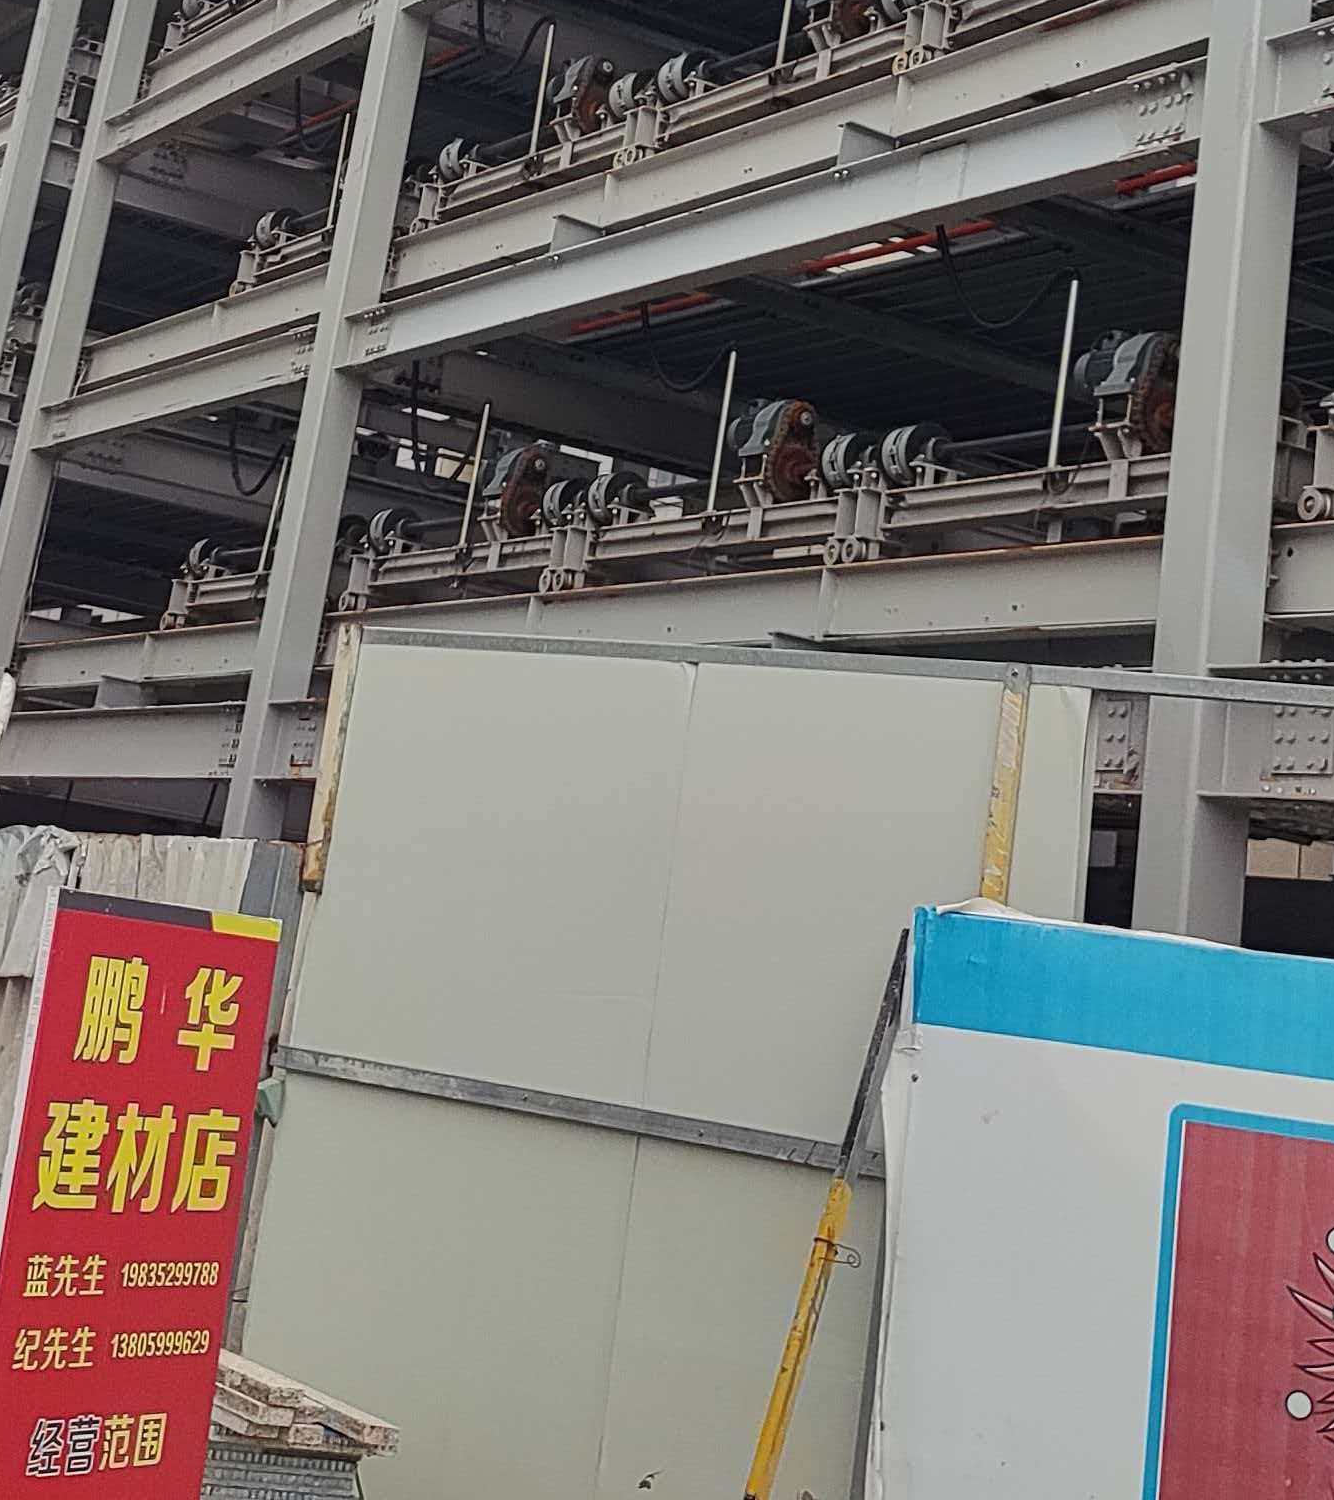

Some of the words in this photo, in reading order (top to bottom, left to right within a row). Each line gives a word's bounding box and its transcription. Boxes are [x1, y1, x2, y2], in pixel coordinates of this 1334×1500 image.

[73, 956, 244, 1072] 鹏华
[32, 1098, 241, 1214] 建材店
[22, 1254, 108, 1297] 蓝先生
[121, 1261, 220, 1288] 19835299788
[11, 1326, 97, 1371] 纪先生
[110, 1329, 210, 1358] 13805999629
[25, 1411, 168, 1478] 经营范围
